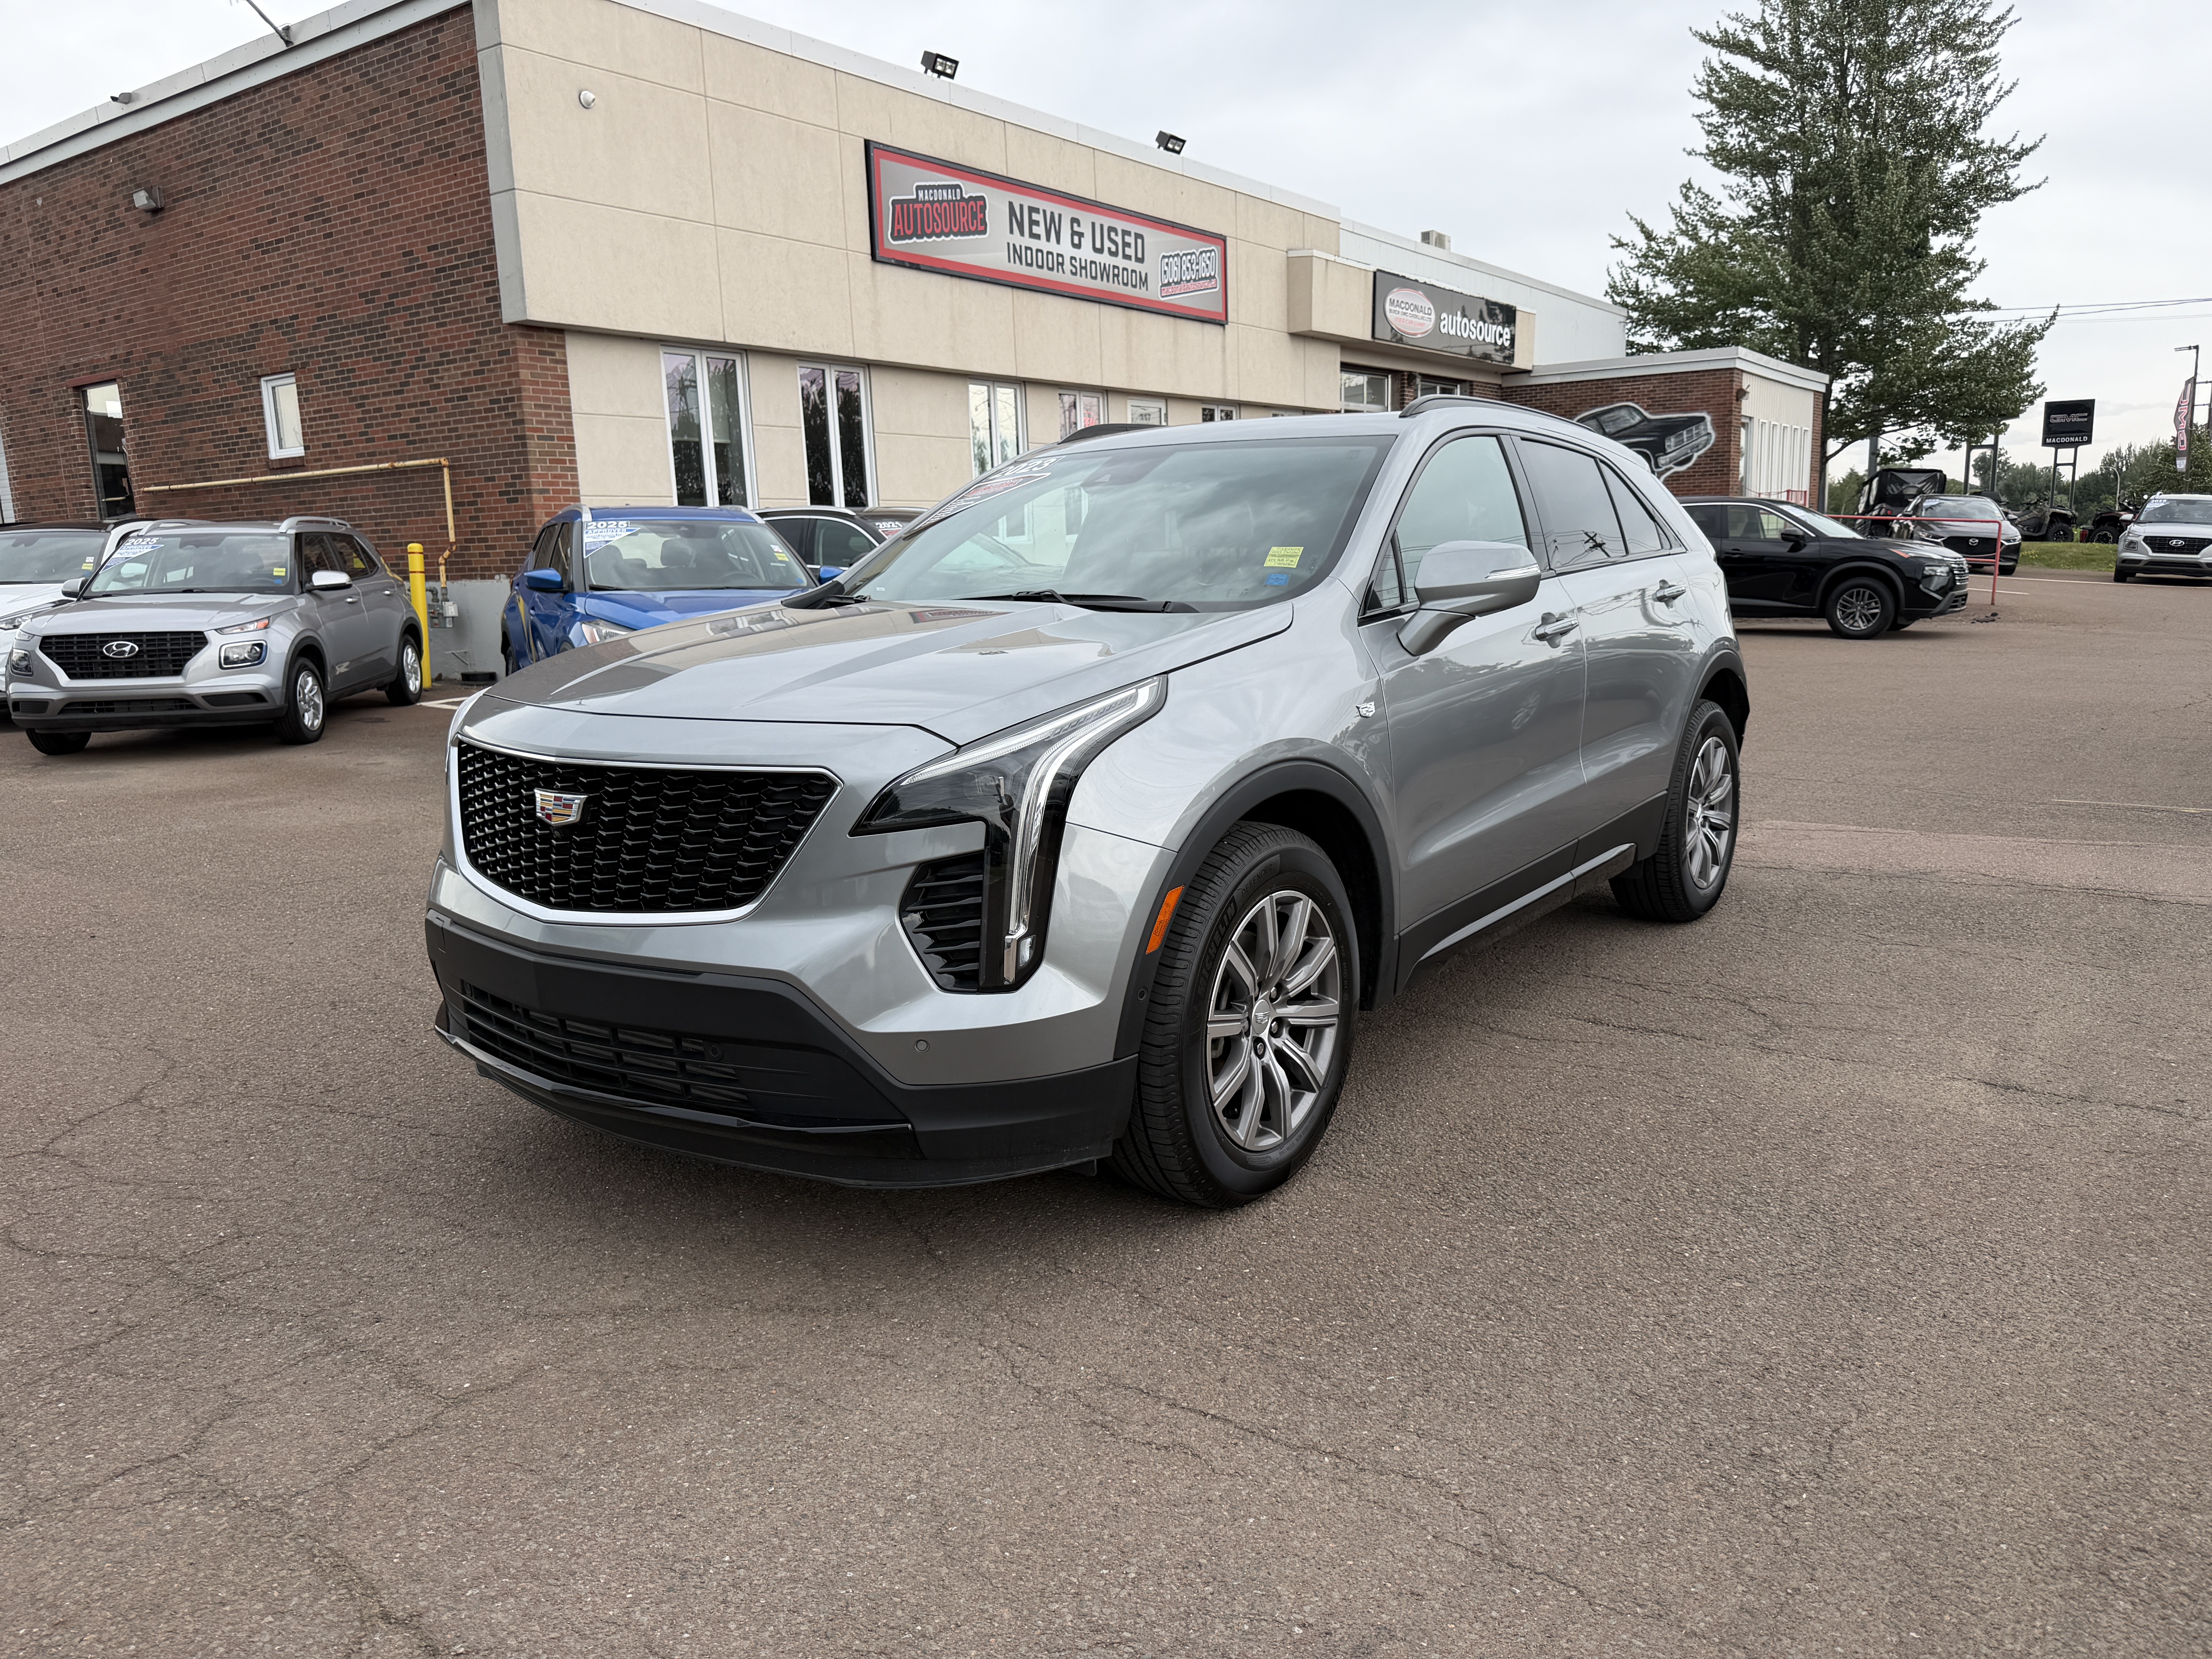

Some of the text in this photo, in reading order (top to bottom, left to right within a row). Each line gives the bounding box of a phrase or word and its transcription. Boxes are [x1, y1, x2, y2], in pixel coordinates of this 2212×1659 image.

[918, 189, 961, 201] MACDONALD
[894, 200, 985, 236] AUTOSOURCE
[1008, 200, 1145, 264] NEW & USED
[1007, 242, 1148, 292] INDOOR SHOWROOM
[1389, 298, 1432, 316] MACDONALD
[1440, 311, 1510, 347] autosource
[2050, 413, 2088, 423] GMC
[2178, 383, 2191, 450] GMC
[988, 458, 1057, 479] 2023
[587, 521, 627, 529] 2025
[1197, 901, 1236, 997] MICHELIN
